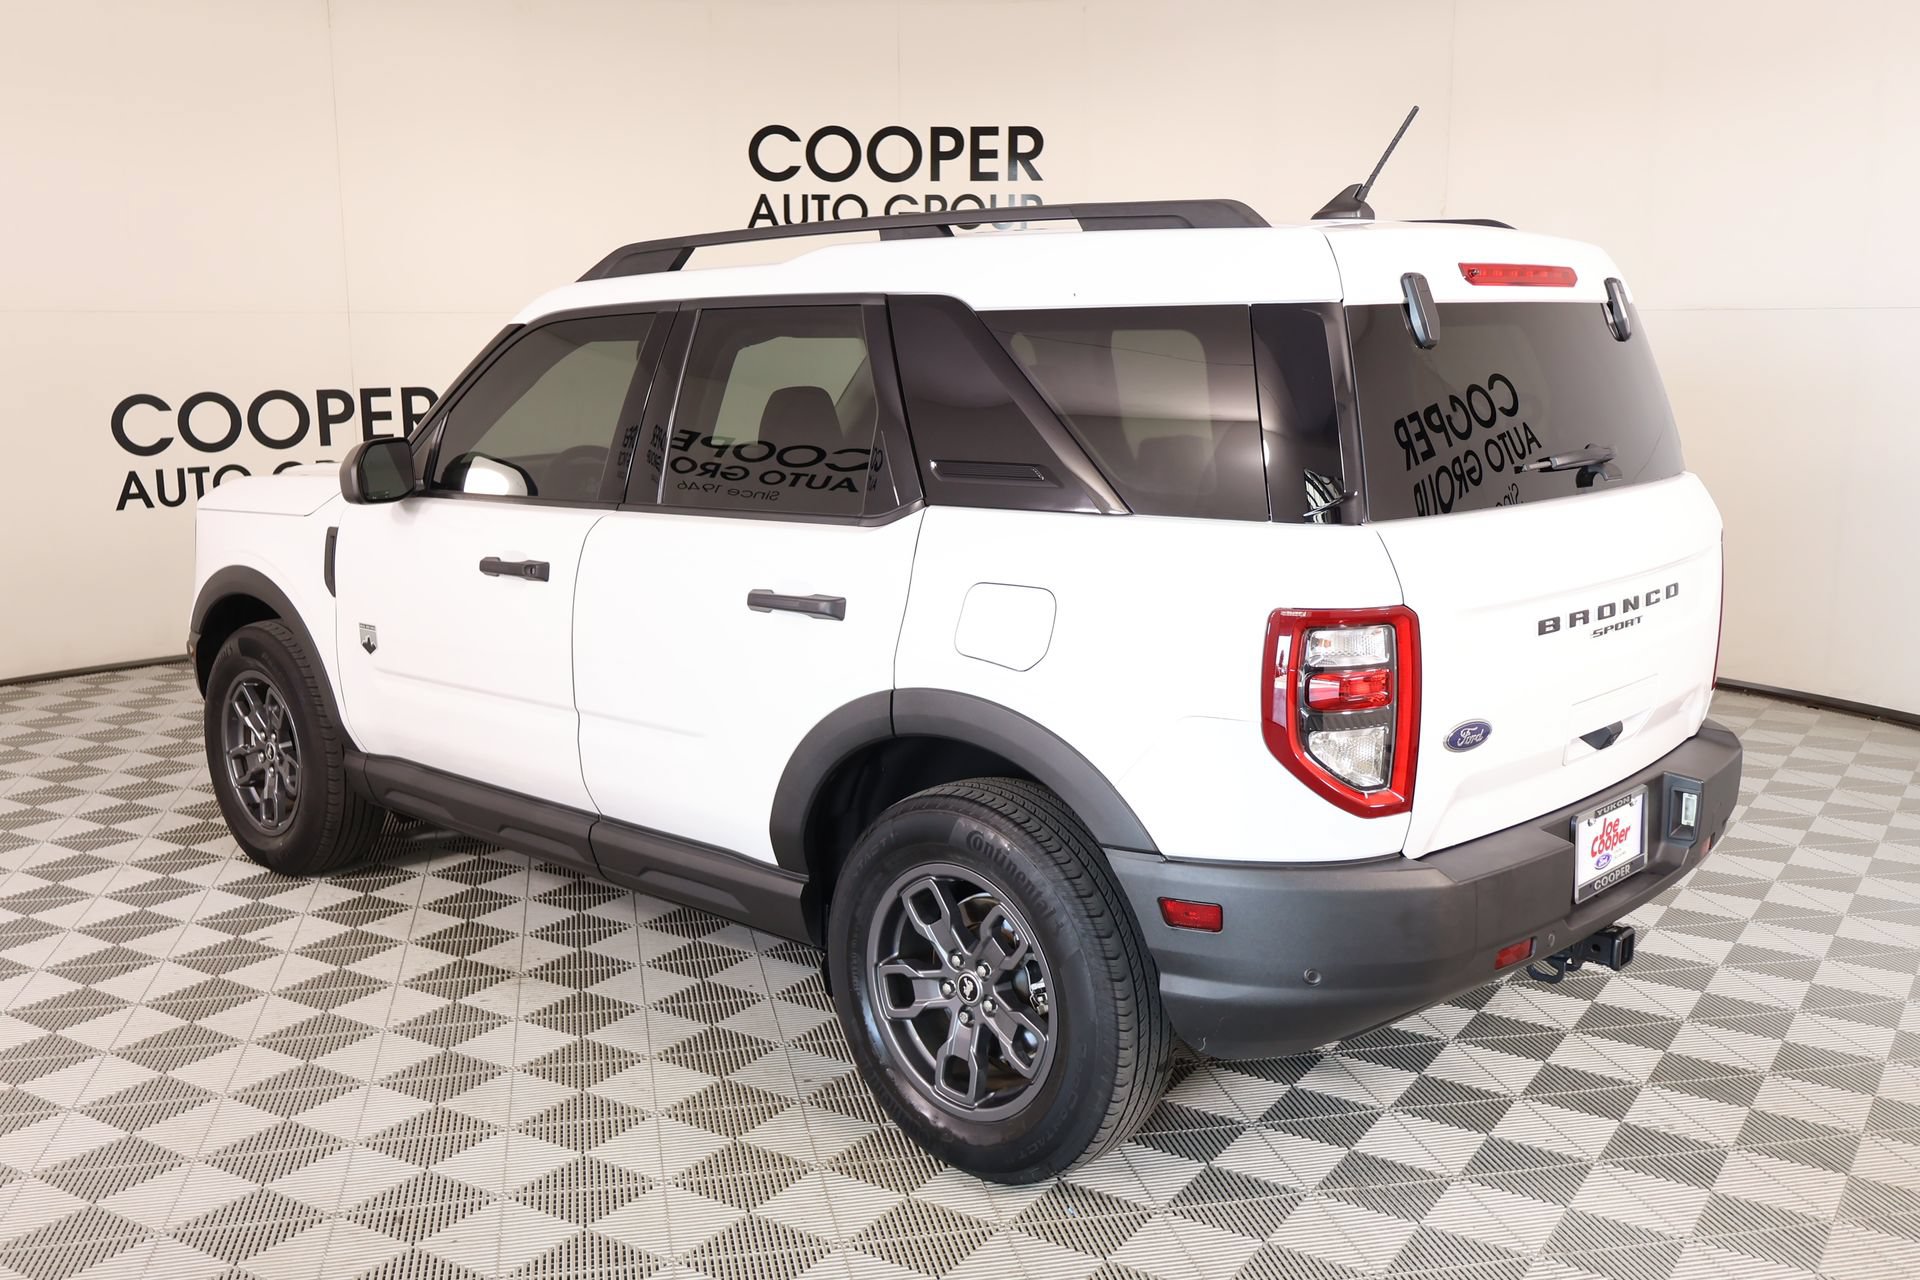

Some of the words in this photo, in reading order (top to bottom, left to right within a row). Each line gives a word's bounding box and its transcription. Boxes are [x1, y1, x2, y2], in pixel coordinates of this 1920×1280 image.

[749, 125, 1044, 182] COOPER
[748, 194, 868, 228] AUTO
[111, 387, 439, 456] COOPER
[1538, 583, 1679, 636] BRONCO
[1591, 615, 1643, 638] SPORT
[1457, 726, 1484, 747] Ford
[1596, 796, 1631, 816] YUKON
[1591, 826, 1630, 858] Cooper
[1599, 818, 1620, 840] Joe
[966, 831, 1056, 919] Continental
[1594, 864, 1631, 890] COOPER
